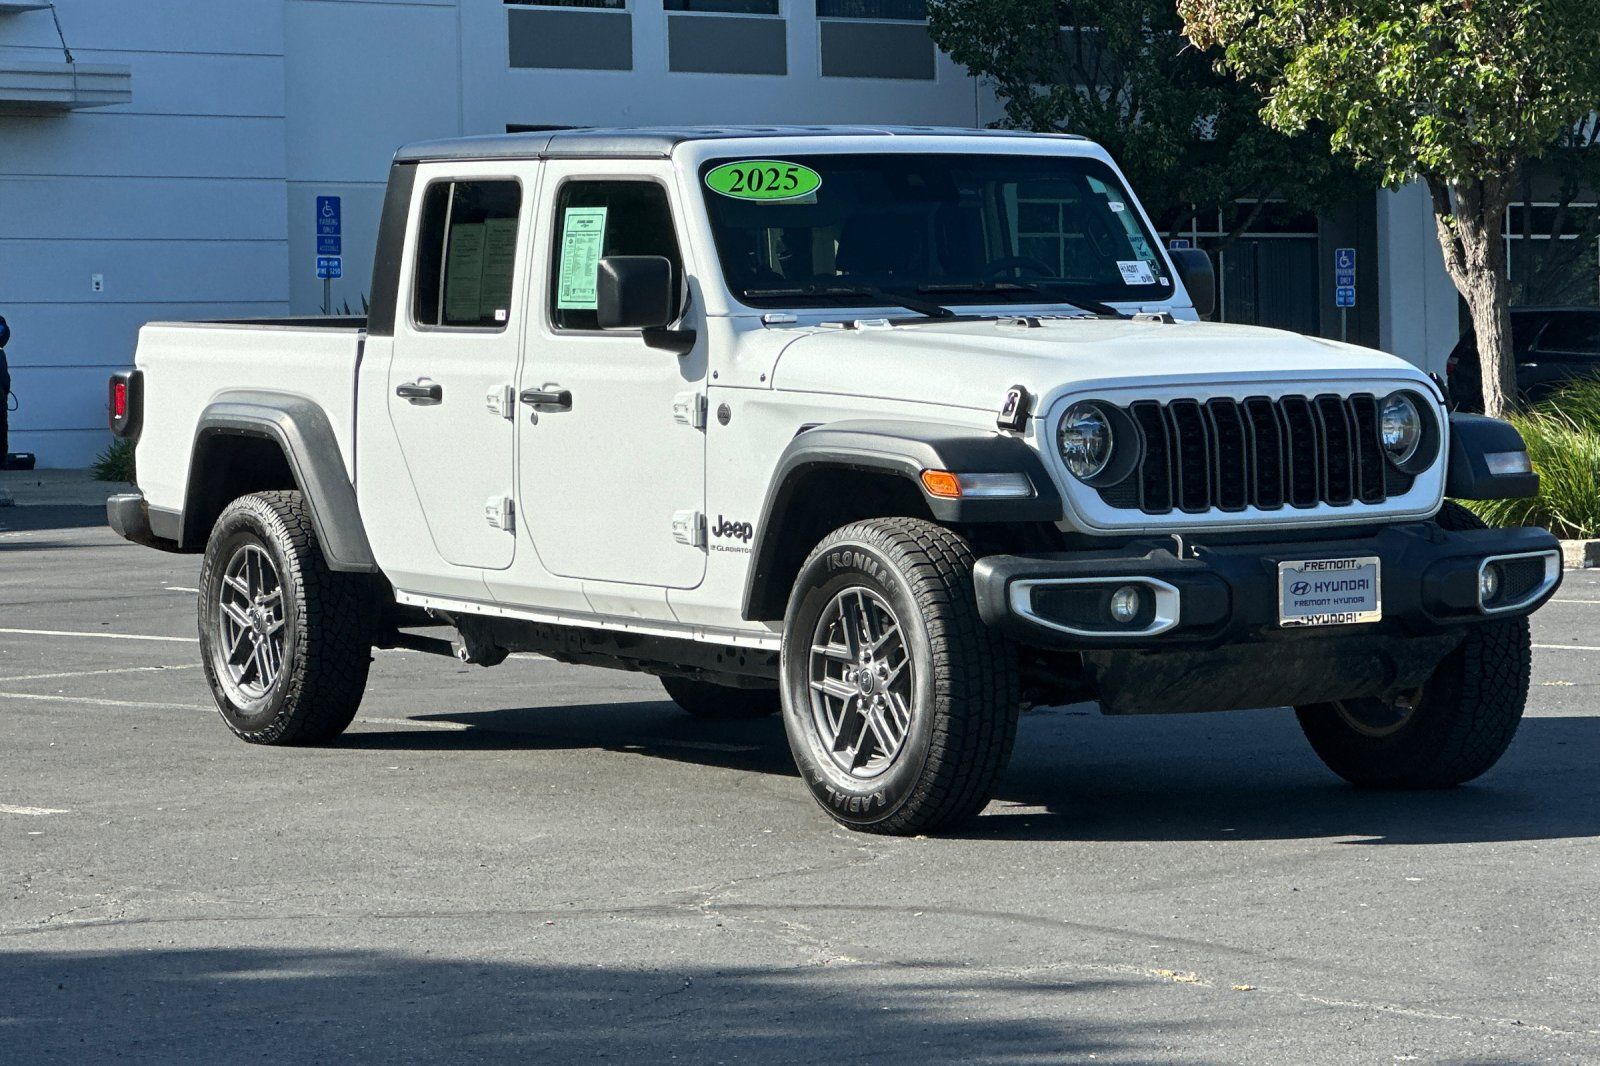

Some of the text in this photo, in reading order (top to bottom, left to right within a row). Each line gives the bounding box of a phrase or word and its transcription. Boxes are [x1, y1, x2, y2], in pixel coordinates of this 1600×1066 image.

[728, 167, 799, 193] 2025
[711, 514, 753, 544] Jeep
[826, 550, 899, 598] IRONMAN
[1303, 559, 1357, 571] FREMONT
[1314, 578, 1369, 593] HYUNDAI
[1294, 596, 1365, 608] FREMONT HYUNDAI
[1306, 612, 1357, 625] HYUNDAI
[825, 784, 887, 813] RADIAL
